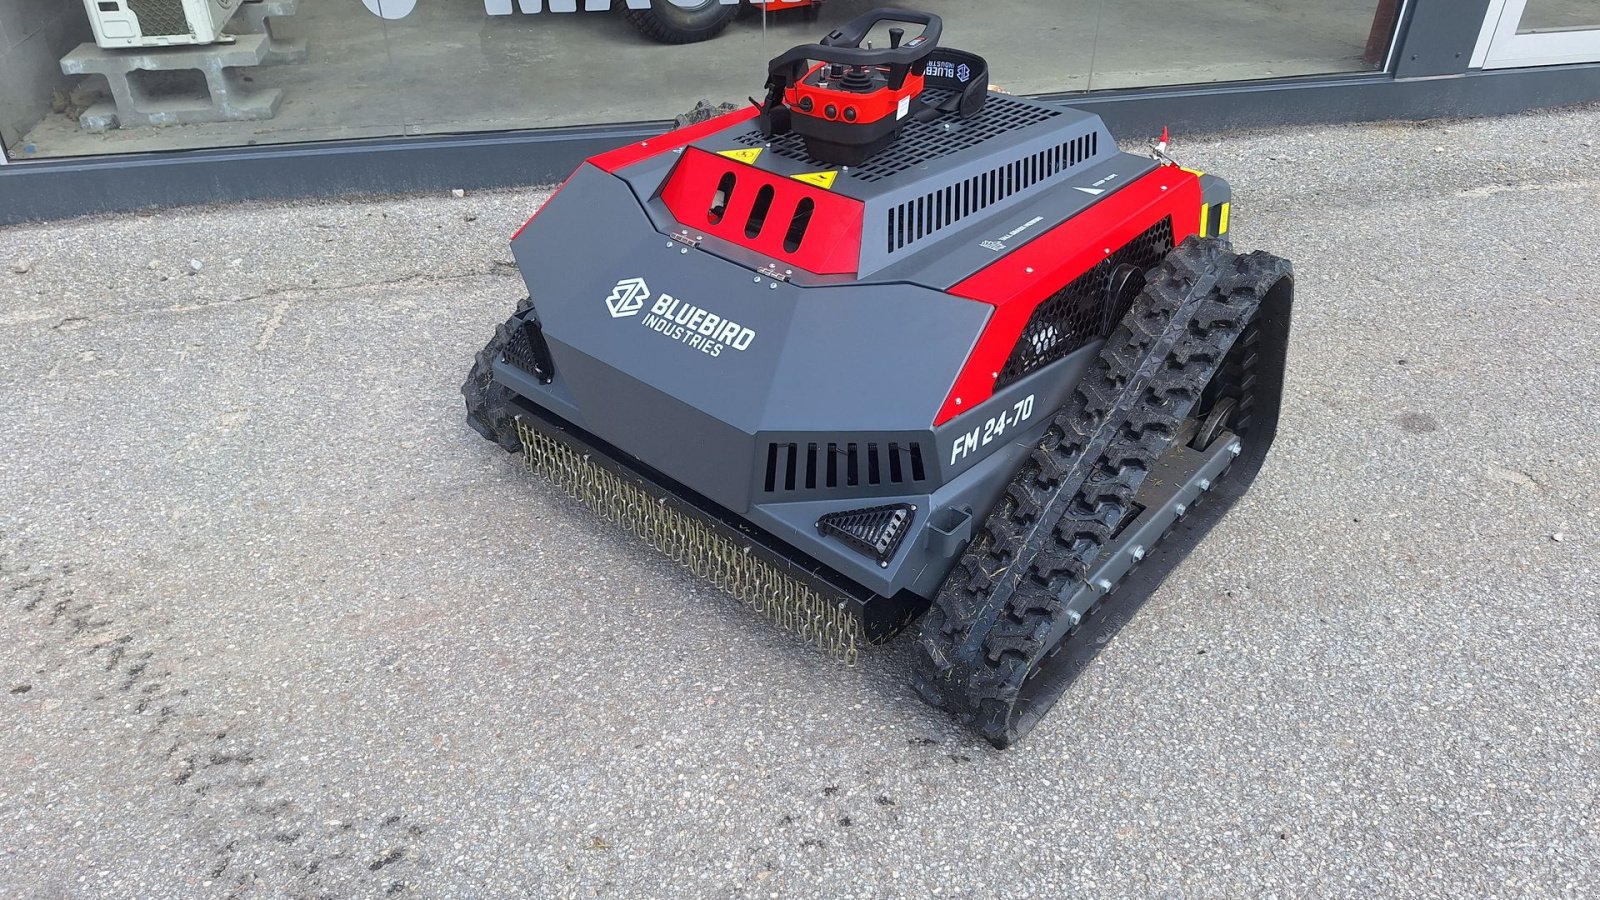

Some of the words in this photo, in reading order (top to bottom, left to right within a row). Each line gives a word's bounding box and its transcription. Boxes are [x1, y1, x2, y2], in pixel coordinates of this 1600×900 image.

[641, 313, 724, 357] INDUSTRIES
[651, 293, 756, 351] BLUEBIRD
[950, 426, 981, 466] FM
[981, 394, 1035, 447] 24-70
